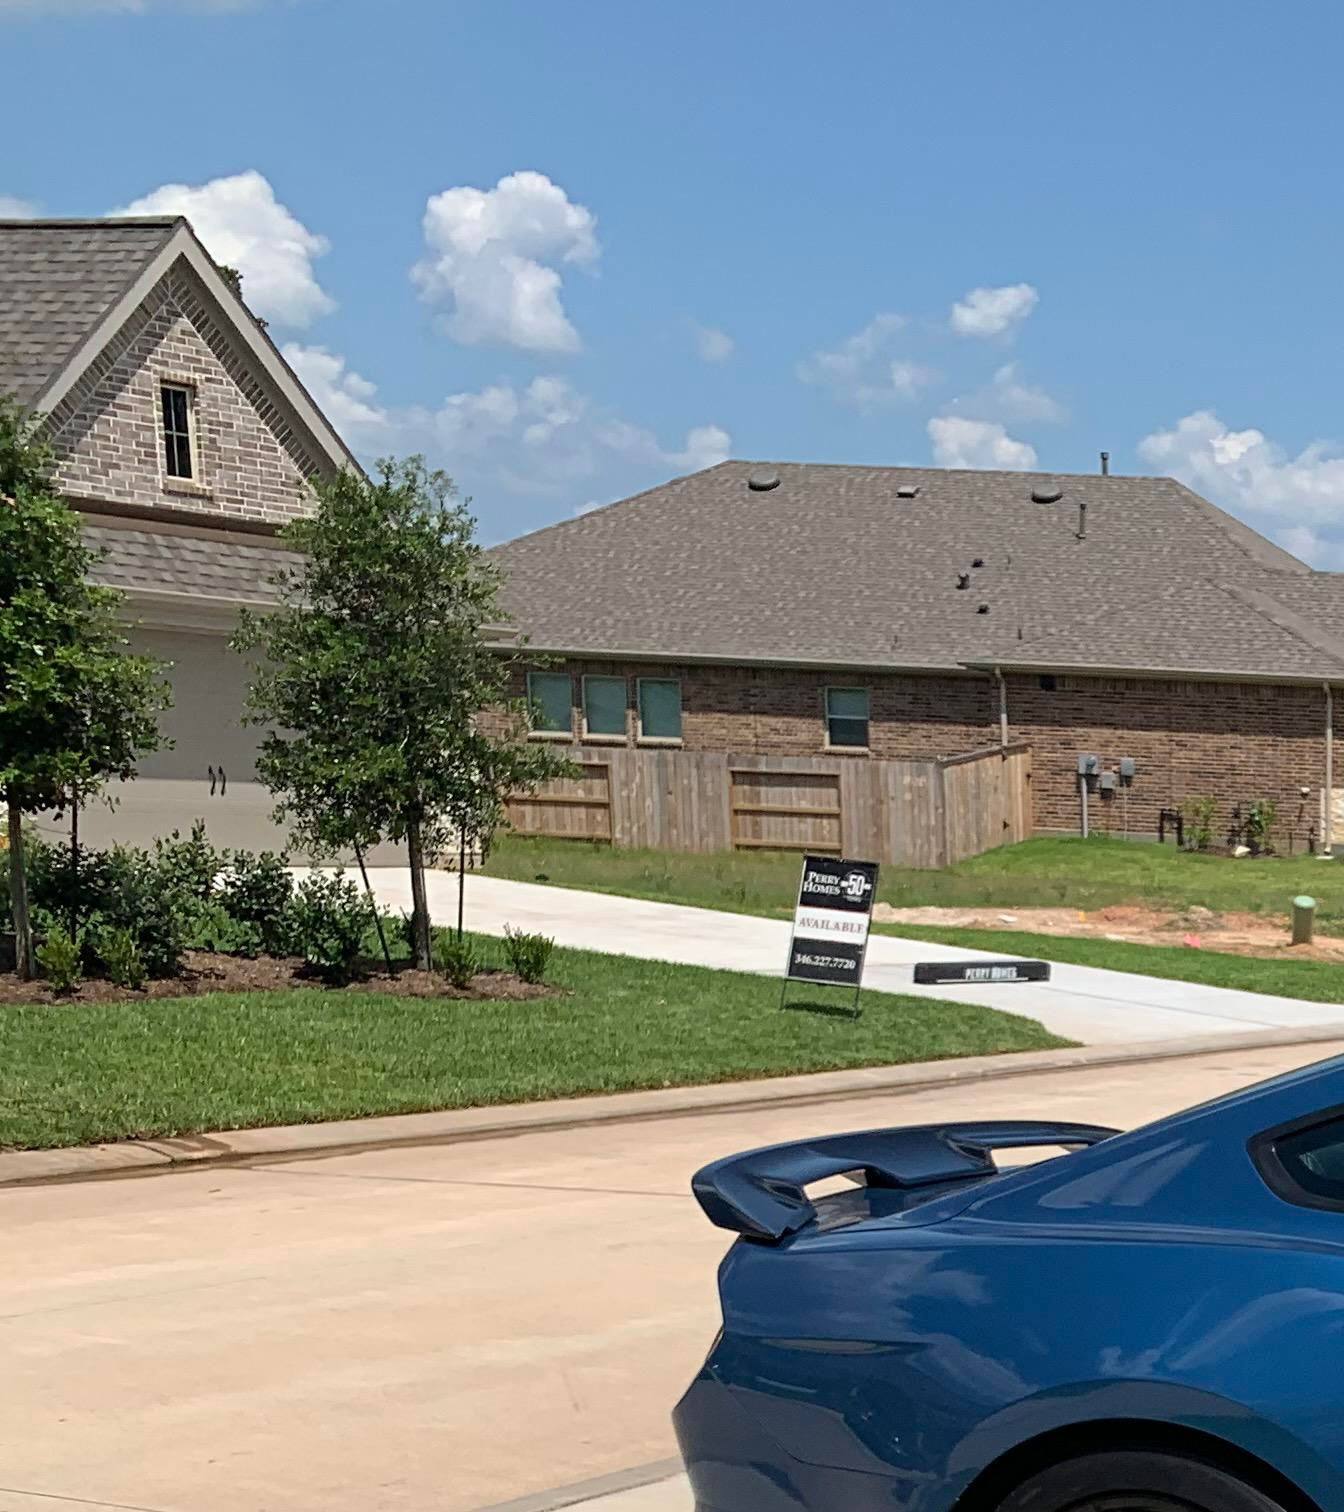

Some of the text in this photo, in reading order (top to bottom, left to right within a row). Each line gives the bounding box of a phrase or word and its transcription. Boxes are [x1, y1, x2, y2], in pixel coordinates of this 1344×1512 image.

[808, 871, 841, 885] PERRY
[847, 874, 866, 896] 50
[803, 881, 841, 895] HOMES
[798, 917, 864, 933] AVAILABLE
